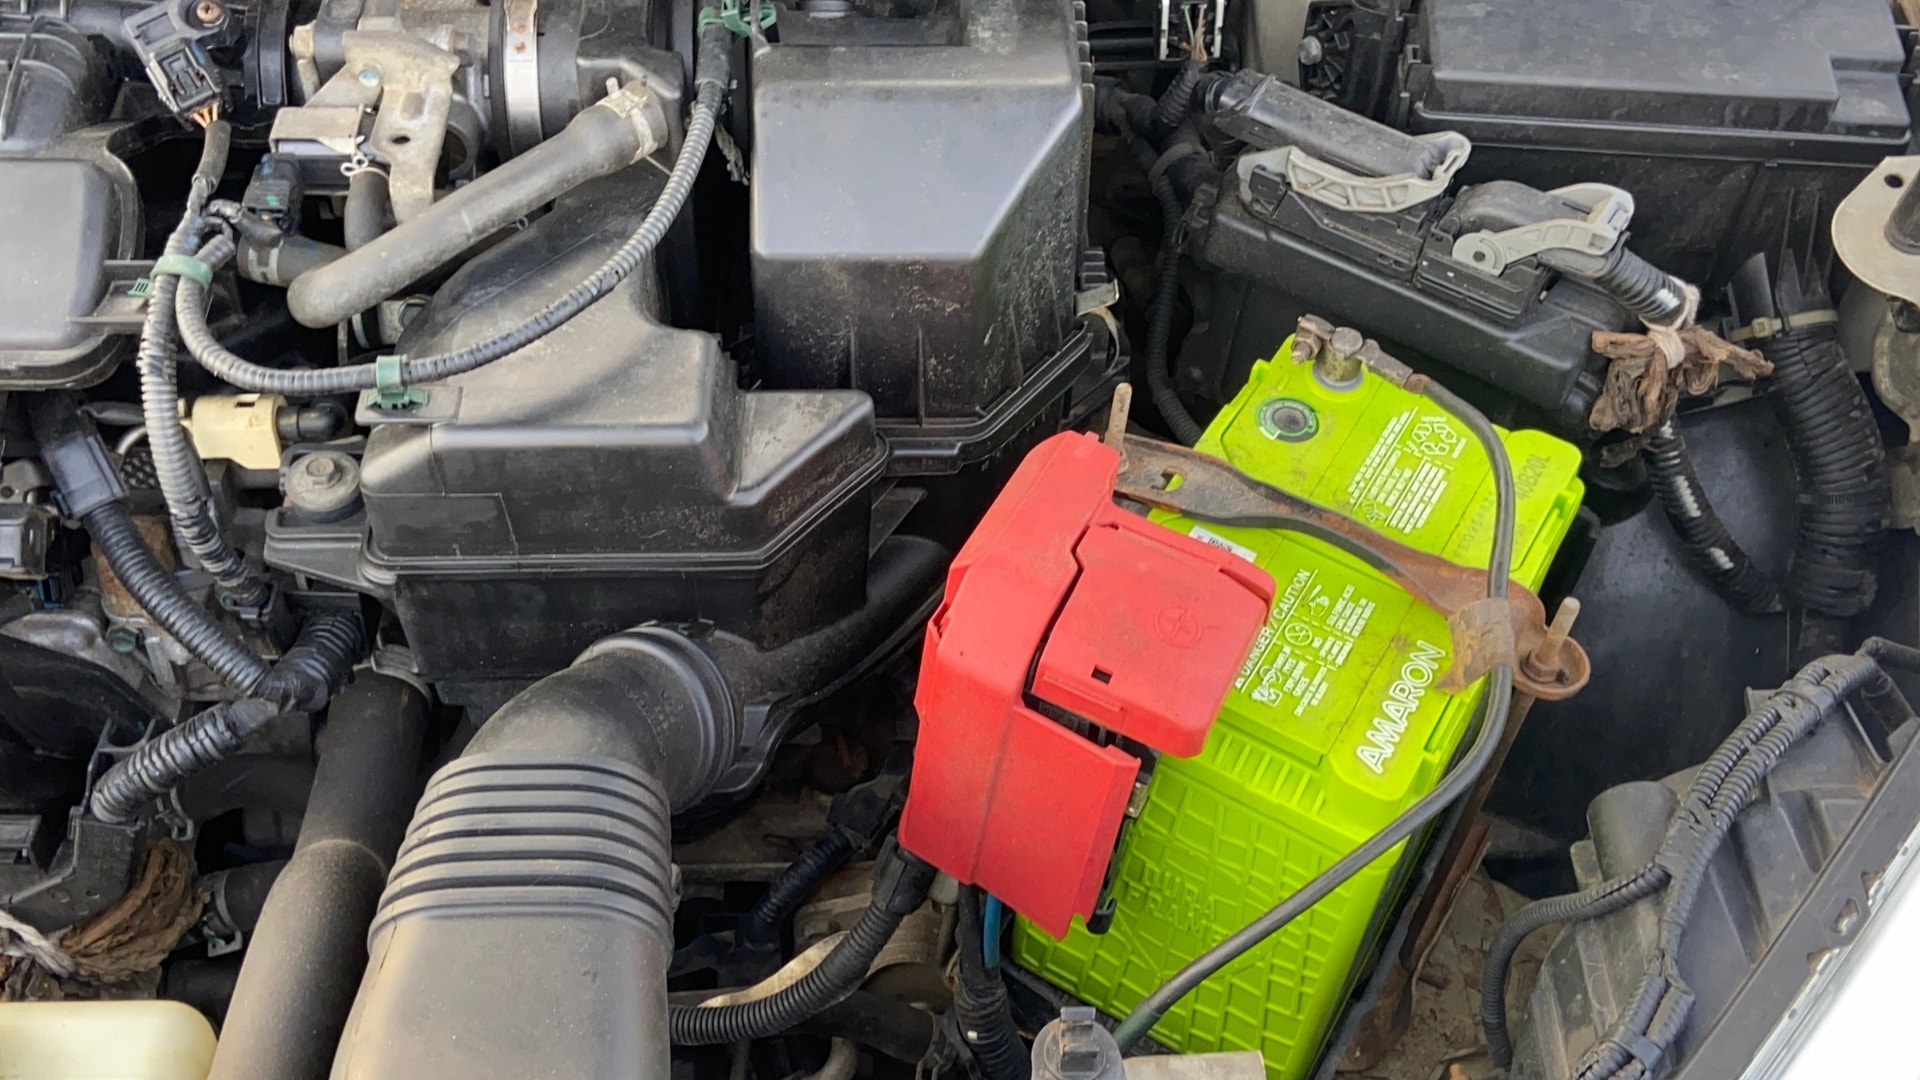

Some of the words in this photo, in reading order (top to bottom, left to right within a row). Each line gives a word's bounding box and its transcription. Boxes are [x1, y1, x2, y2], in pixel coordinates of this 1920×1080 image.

[1273, 568, 1311, 620] CAUTION
[1356, 640, 1446, 775] AMARON
[1142, 861, 1215, 920] DURA
